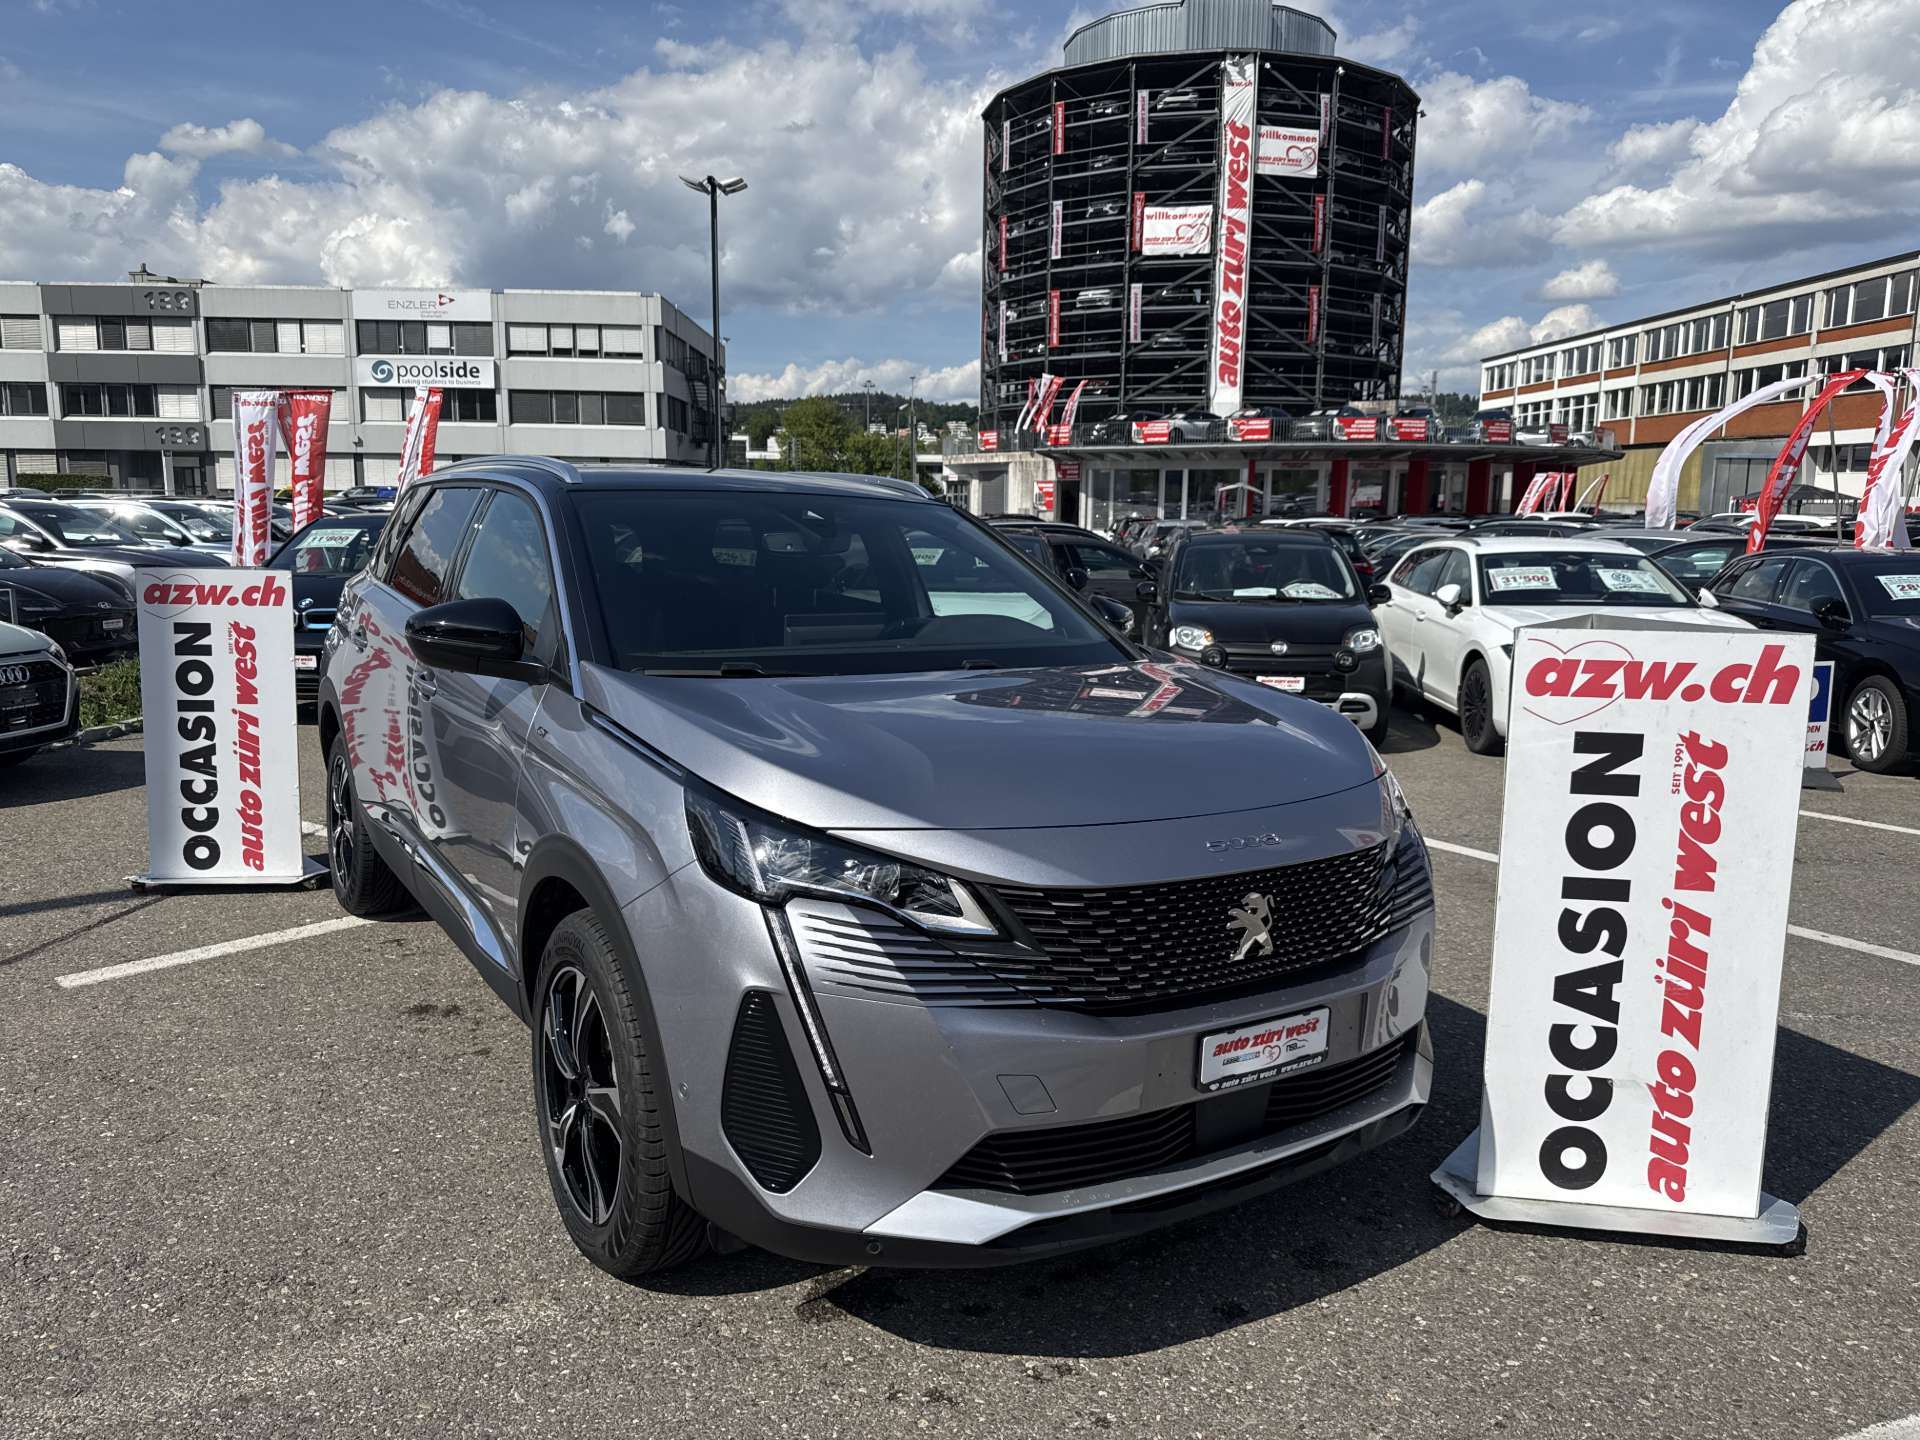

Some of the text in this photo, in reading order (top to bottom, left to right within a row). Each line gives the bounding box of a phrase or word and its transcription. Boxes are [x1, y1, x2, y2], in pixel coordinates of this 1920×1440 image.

[1218, 119, 1251, 388] auto züri west
[144, 291, 189, 310] 139
[388, 300, 437, 310] ENZLER
[397, 361, 480, 384] poolside
[402, 378, 420, 386] taking
[421, 378, 447, 386] students
[155, 427, 200, 445] 139
[143, 575, 286, 608] azw.ch
[1525, 644, 1801, 705] azw.ch
[173, 622, 221, 871] OCCASION
[228, 620, 264, 872] auto züri west
[1671, 743, 1684, 795] SEIT 1991
[1539, 731, 1645, 1191] OCCASION
[1646, 730, 1729, 1203] auto züri west
[1213, 1016, 1320, 1057] auto züri west
